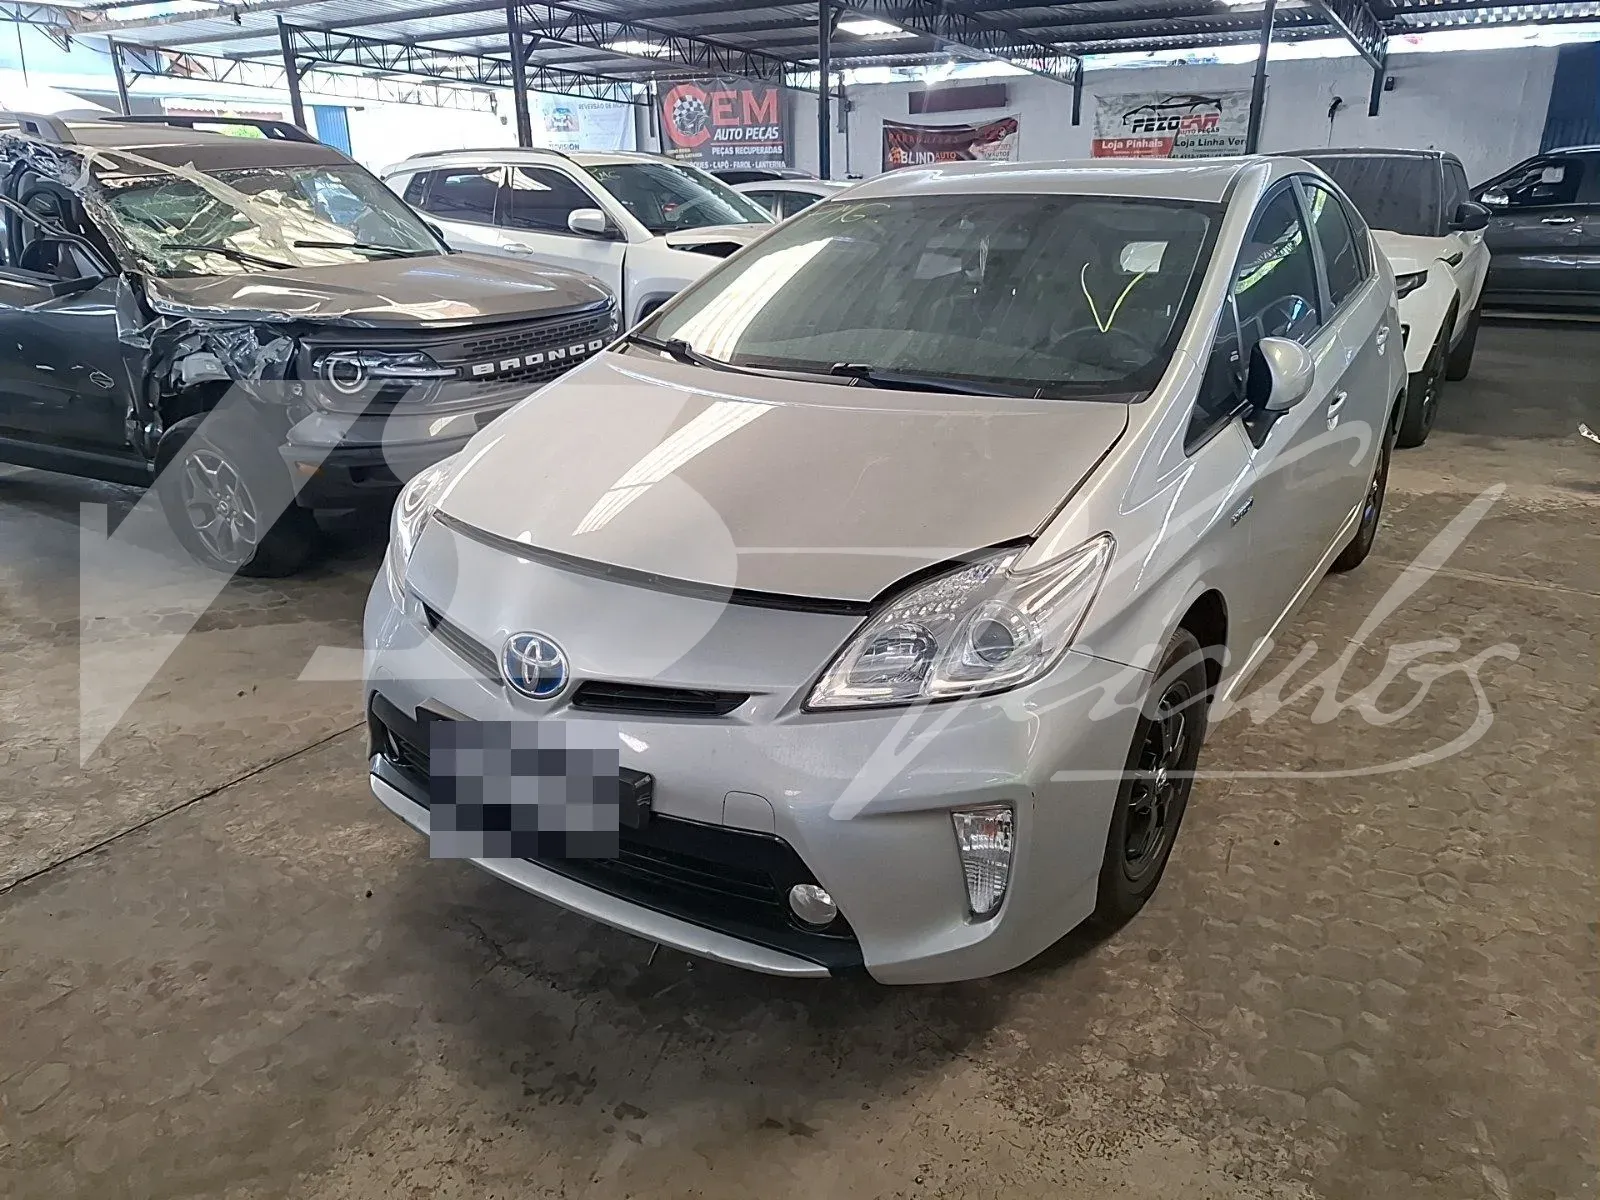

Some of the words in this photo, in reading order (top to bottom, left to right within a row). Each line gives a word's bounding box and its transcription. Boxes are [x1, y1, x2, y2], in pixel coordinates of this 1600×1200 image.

[1132, 113, 1220, 133] PEZOCAR
[714, 128, 743, 140] AUTO
[745, 126, 779, 141] PEÇAS
[1102, 141, 1123, 150] Loja
[1174, 139, 1195, 148] Loja
[1198, 138, 1225, 146] Linha
[712, 147, 734, 157] PEÇAS
[735, 146, 783, 155] RECUPERADAS
[900, 151, 935, 165] BLIND
[935, 152, 957, 160] AUTO
[755, 161, 787, 169] LANTERNA
[472, 339, 603, 376] BRONCO
